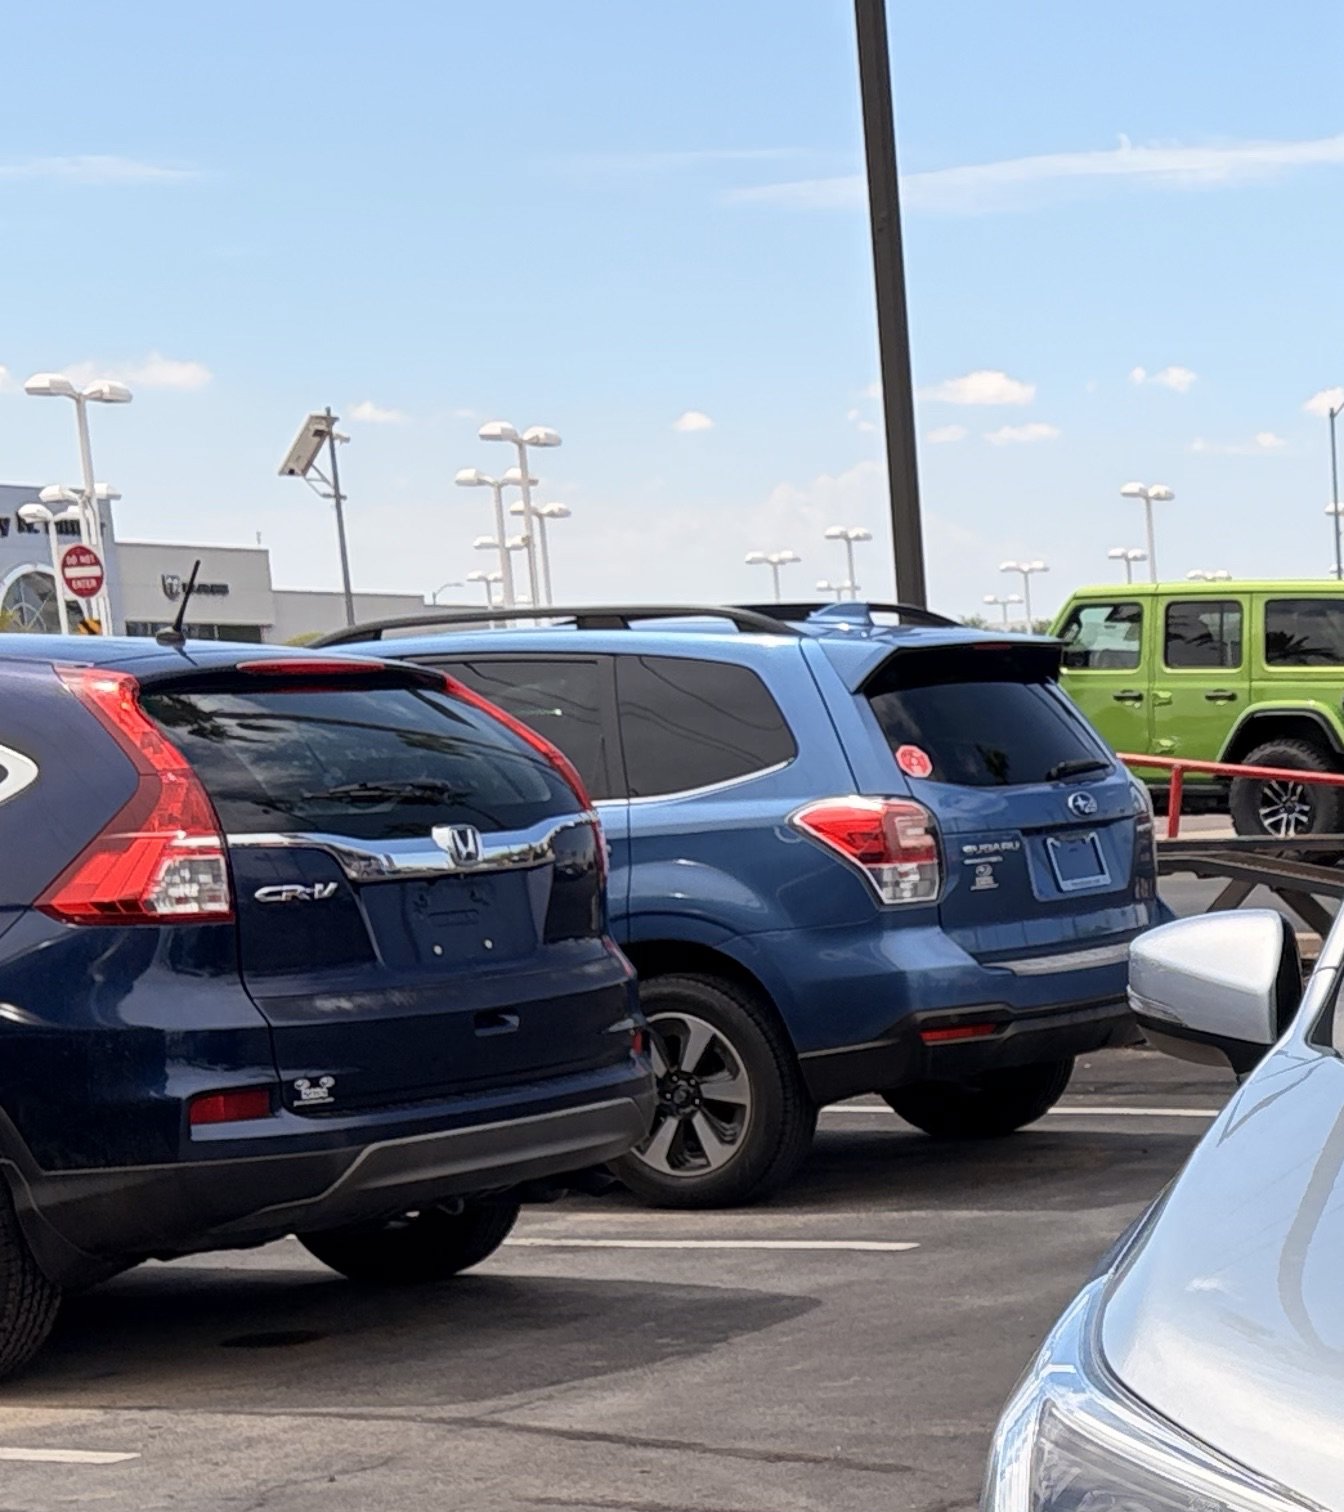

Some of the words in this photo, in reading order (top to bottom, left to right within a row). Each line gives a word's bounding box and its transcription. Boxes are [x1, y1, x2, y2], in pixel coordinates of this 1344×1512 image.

[66, 554, 78, 566] DO
[79, 553, 96, 565] NOT
[71, 578, 97, 590] ENTER
[962, 840, 1021, 854] SUBARU
[254, 881, 338, 902] CR-V
